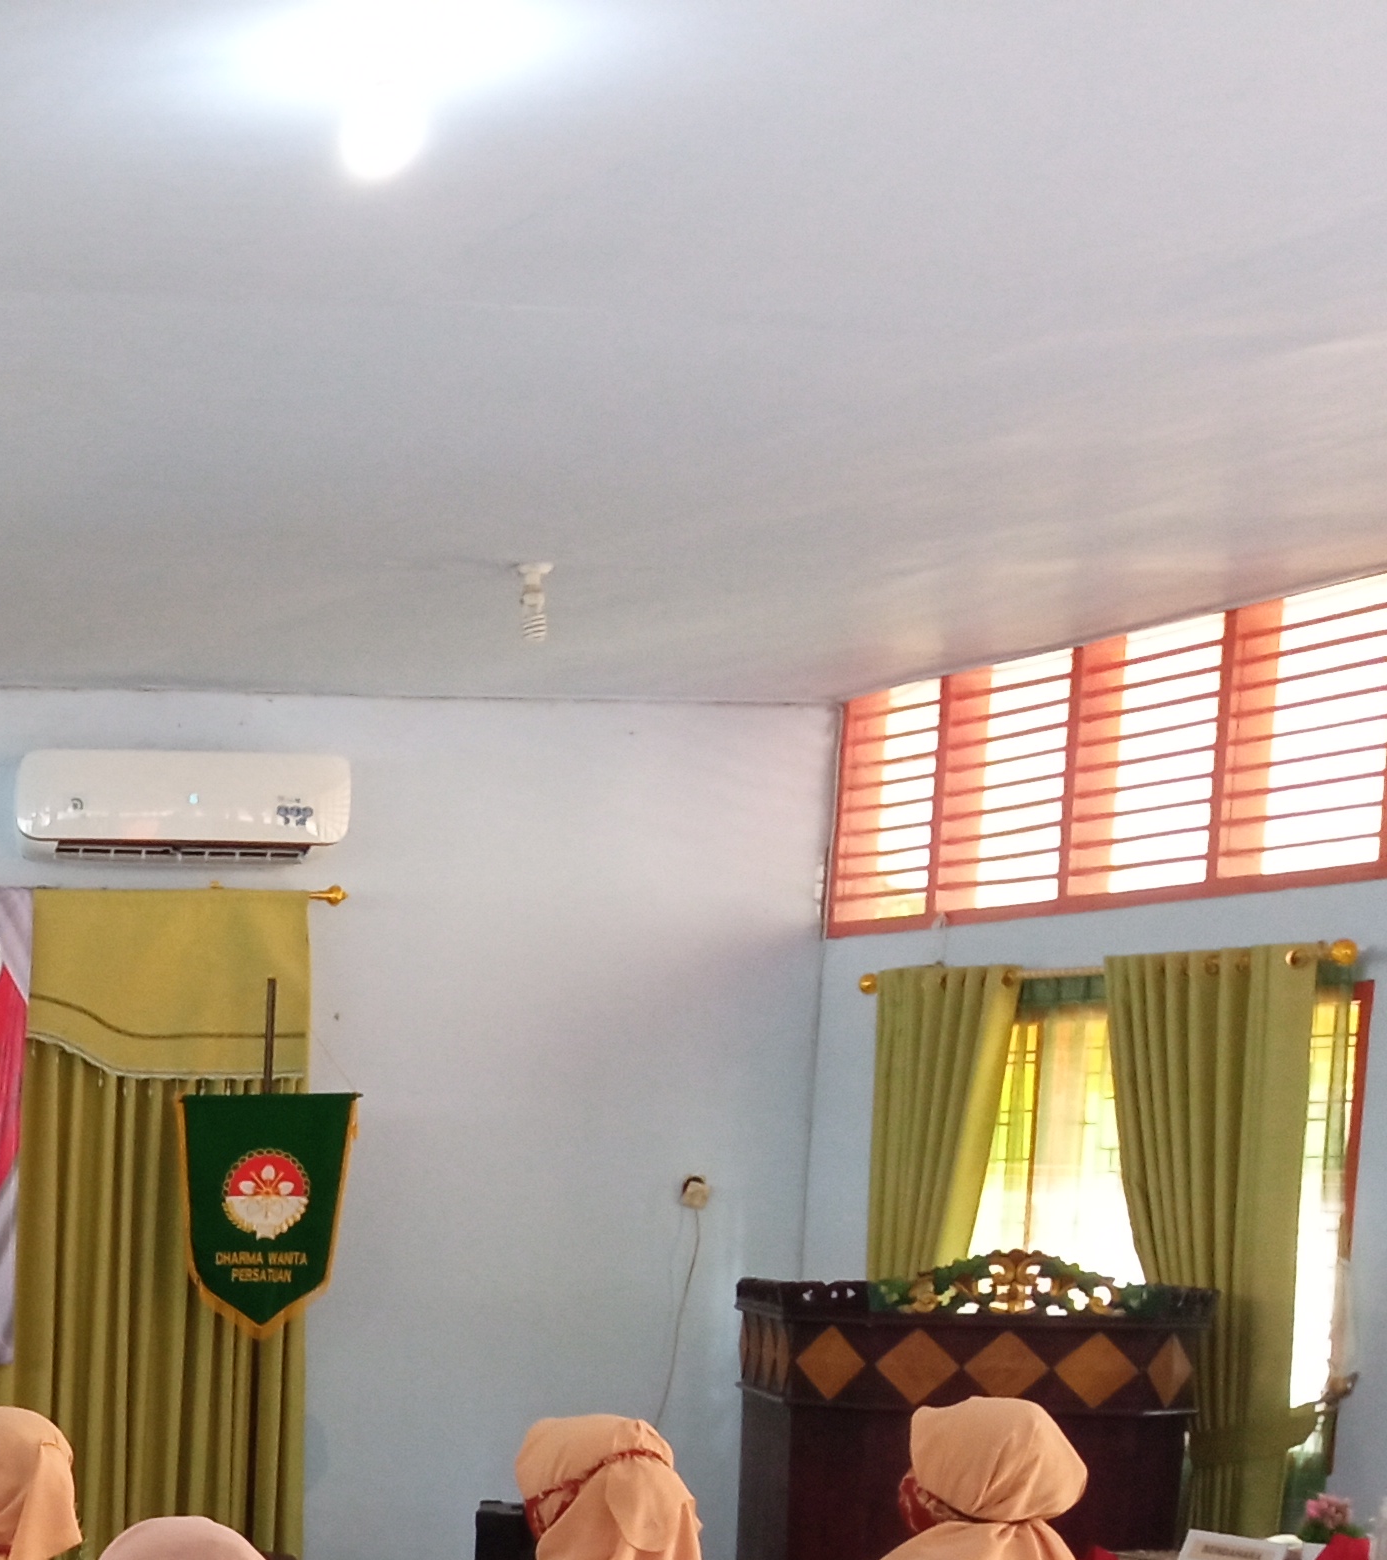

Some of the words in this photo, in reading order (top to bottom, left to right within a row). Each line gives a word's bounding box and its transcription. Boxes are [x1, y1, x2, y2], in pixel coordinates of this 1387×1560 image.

[215, 1251, 263, 1265] DHARMA
[268, 1251, 307, 1265] WANITA
[231, 1268, 292, 1282] PERSATUAN
